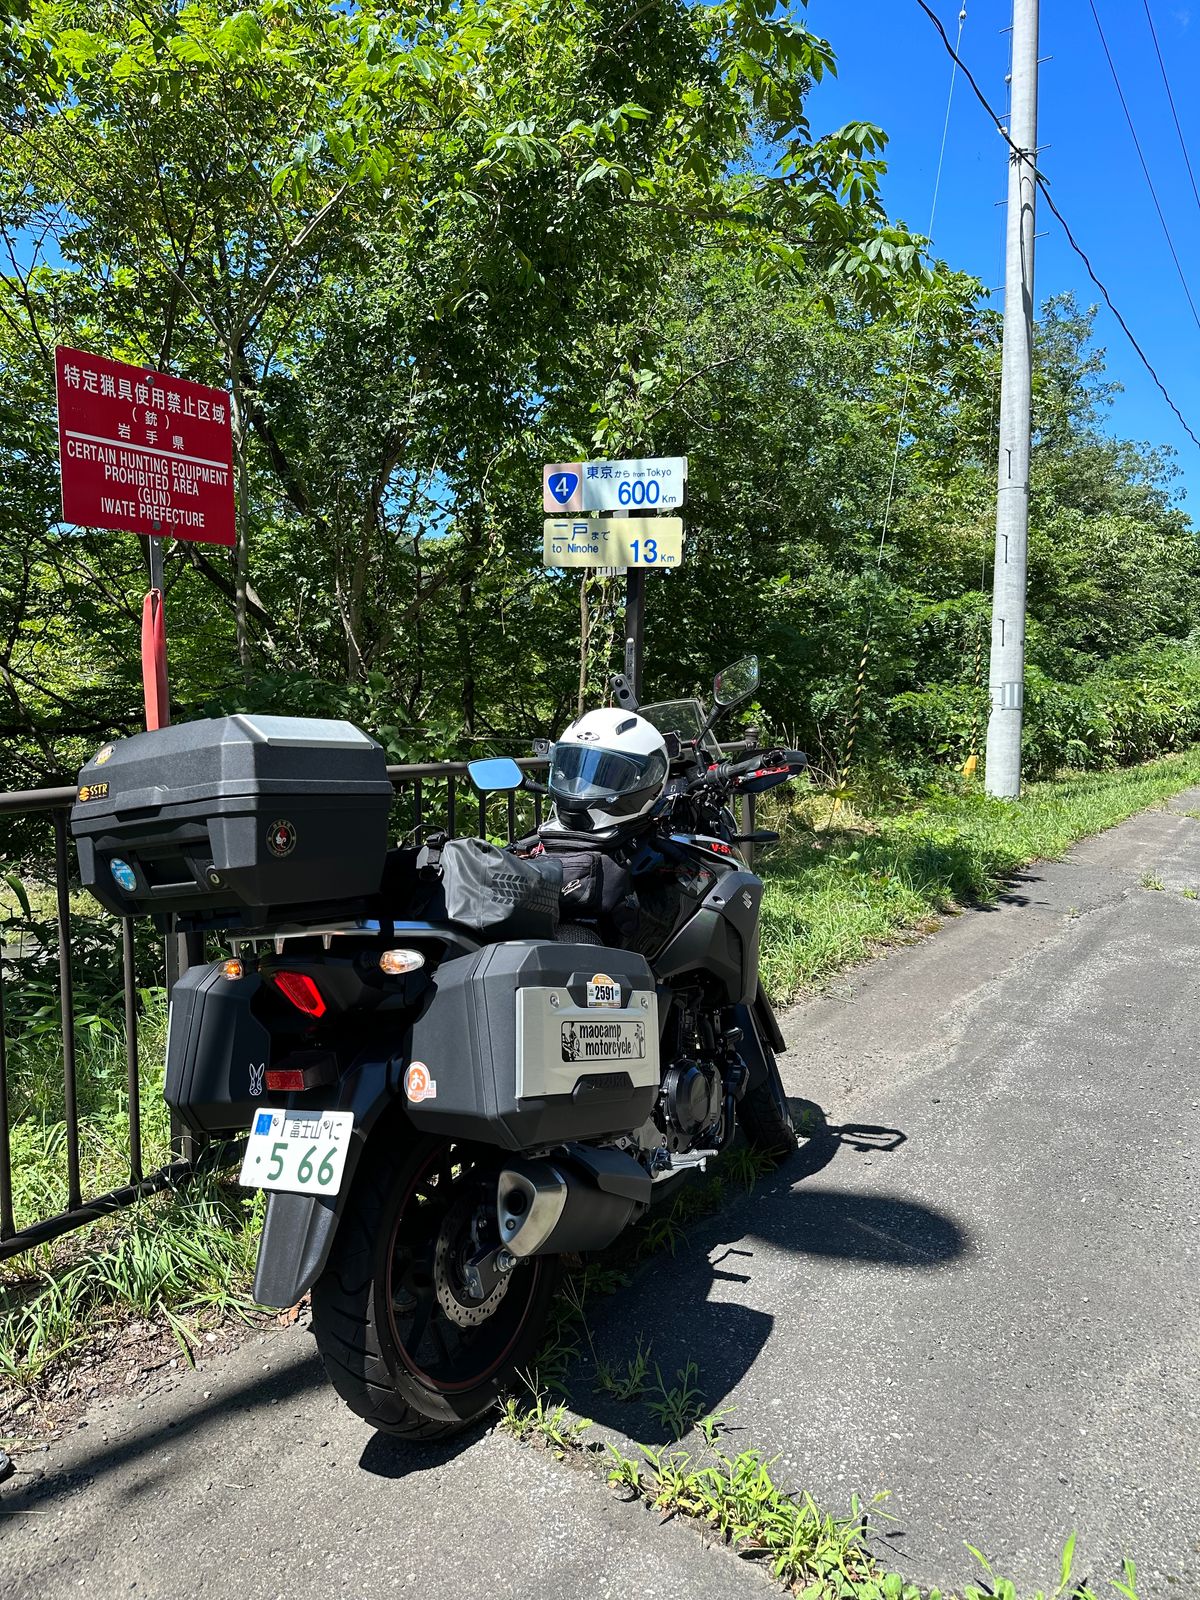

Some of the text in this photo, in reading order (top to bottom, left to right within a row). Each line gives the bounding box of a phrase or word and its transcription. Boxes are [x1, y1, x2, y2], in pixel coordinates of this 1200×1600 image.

[63, 363, 225, 425] 特定猟具使用禁止区域
[118, 422, 185, 450] 岩手県
[66, 440, 229, 487] CERTAIN HUNTING EQUIPMENT
[586, 466, 630, 480] 東京から
[646, 468, 672, 478] Tokyo
[104, 464, 199, 496] PROHIBITED AREA
[555, 476, 569, 497] 4
[137, 487, 171, 507] (GUN)
[618, 480, 677, 505] 600 Km
[101, 496, 205, 528] IWATE PREFECTURE
[552, 523, 611, 541] 二戸まで
[552, 544, 599, 553] to Ninohe
[630, 538, 675, 564] 13 Km
[89, 783, 108, 796] SSTR
[595, 985, 615, 1001] 2591
[579, 1024, 622, 1042] maocamp
[585, 1037, 632, 1058] motorcycle
